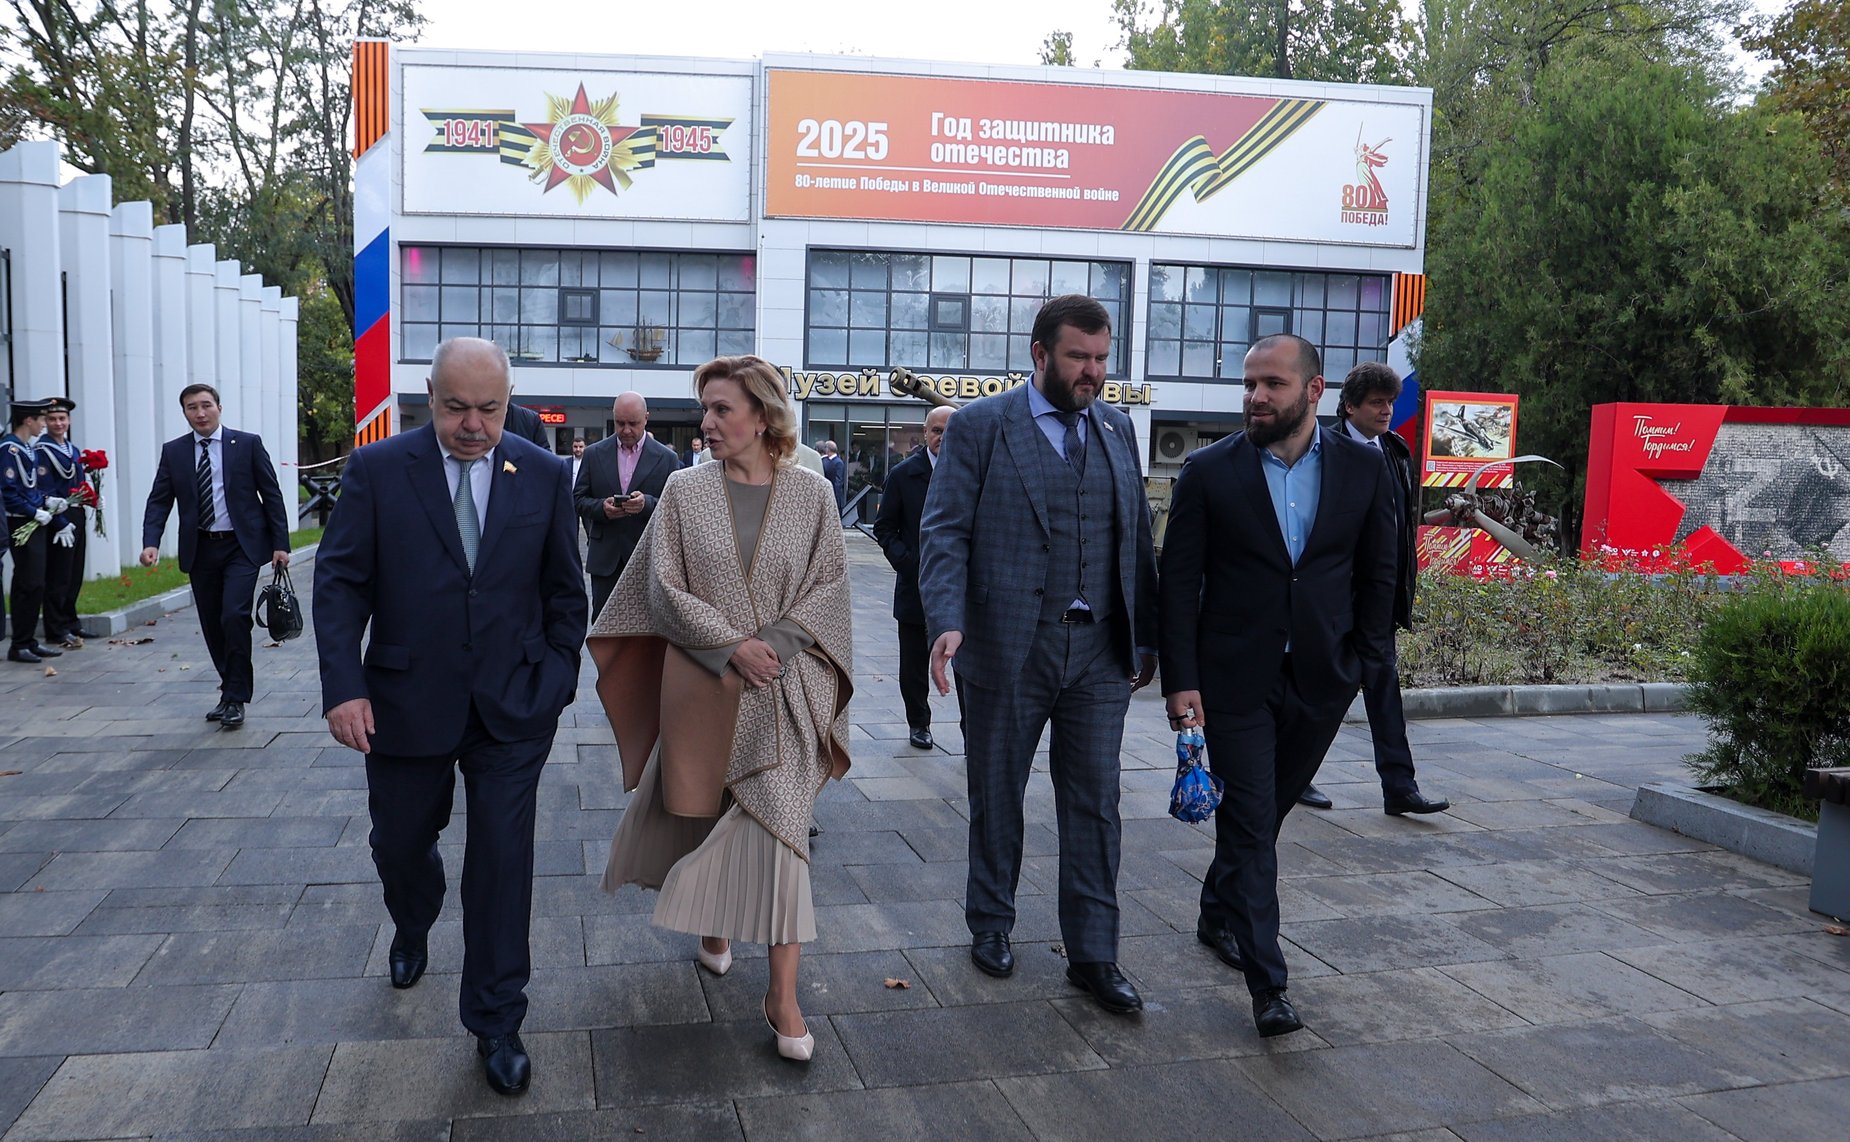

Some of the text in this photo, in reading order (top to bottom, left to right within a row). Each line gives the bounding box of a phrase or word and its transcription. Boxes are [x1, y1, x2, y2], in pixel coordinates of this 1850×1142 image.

[443, 119, 493, 147] 1941
[661, 125, 712, 153] 1945
[796, 118, 889, 160] 2025
[931, 112, 1115, 145] Год защитника
[552, 116, 605, 169] ОТЕЧЕСТВЕННАЯ
[930, 142, 1069, 169] отечества
[795, 174, 1120, 201] 80-летие Победы в Великой Отечественной войне
[1342, 184, 1368, 208] 80
[1341, 211, 1389, 227] ПОБЕДА!
[1633, 415, 1681, 437] Помним!
[1641, 434, 1695, 460] Гордимся!
